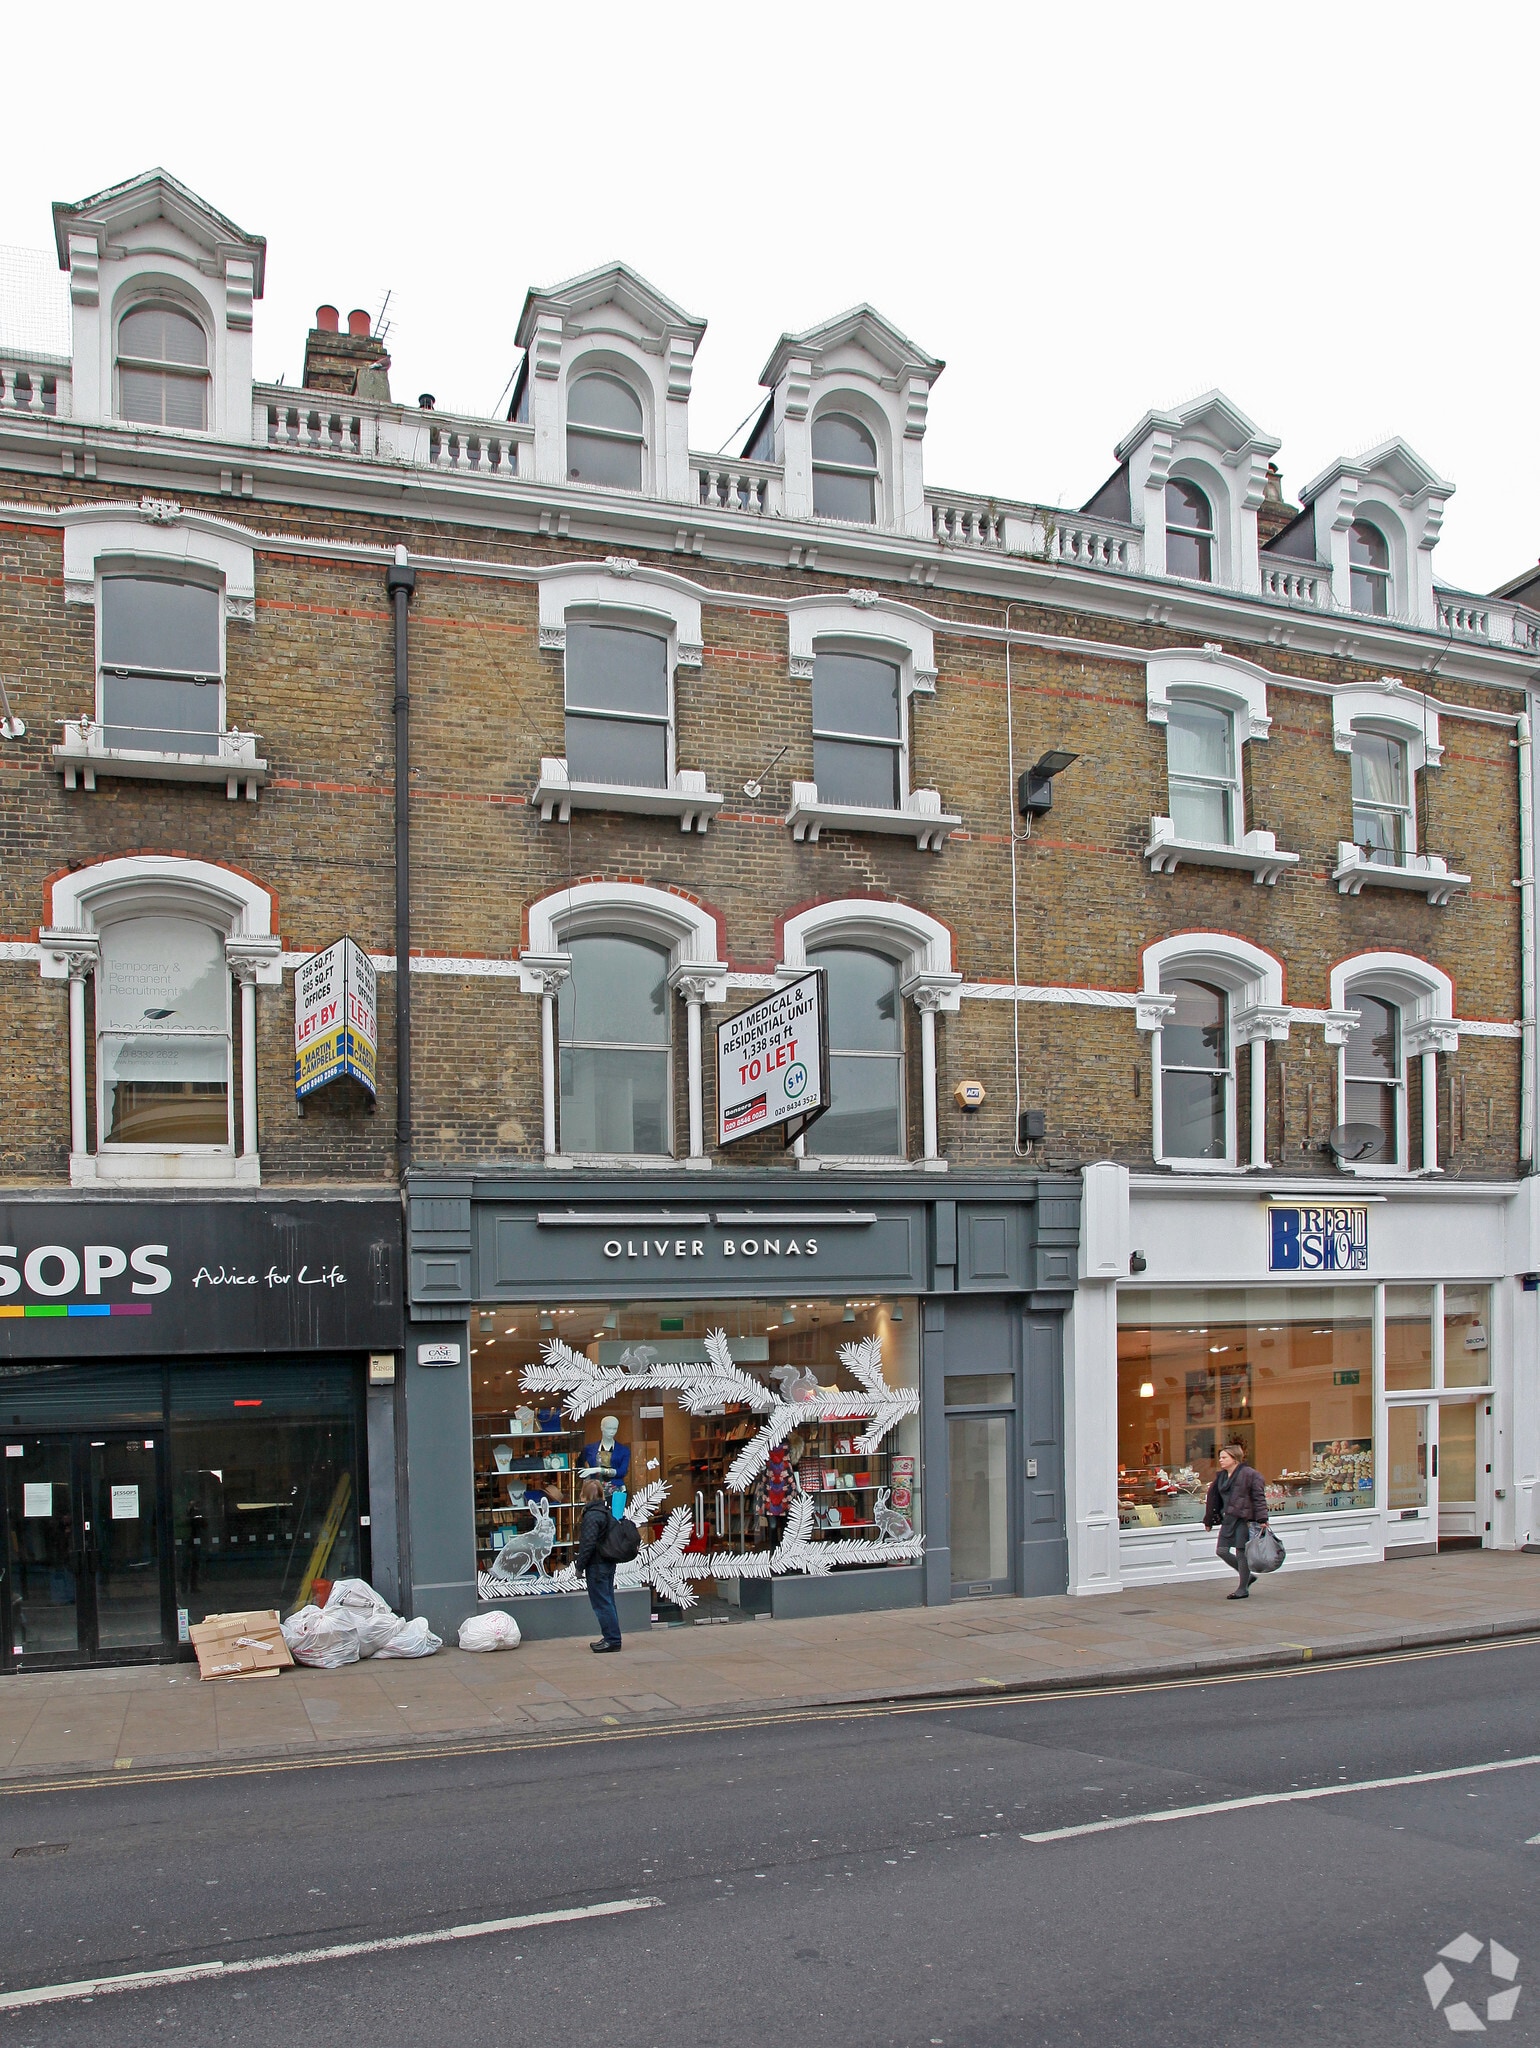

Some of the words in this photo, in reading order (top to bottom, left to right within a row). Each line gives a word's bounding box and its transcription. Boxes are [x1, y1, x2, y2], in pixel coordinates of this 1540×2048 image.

[109, 960, 169, 974] Temporary
[172, 963, 181, 973] &
[109, 973, 172, 984] Permanent
[302, 964, 313, 981] 356
[109, 984, 178, 997] Recruitment
[302, 980, 314, 996] 885
[304, 983, 331, 1009] OFFICES
[298, 1013, 318, 1041] LET
[320, 1000, 338, 1026] BY
[731, 1020, 744, 1037] D1
[746, 994, 793, 1029] MEDICAL
[795, 988, 804, 1002] &
[723, 1013, 786, 1056] RESIDENTIAL
[788, 998, 814, 1021] UNIT
[305, 1040, 332, 1066] MARTIN
[742, 1037, 768, 1060] 1,338
[769, 1033, 781, 1046] sq
[783, 1024, 793, 1039] ft
[302, 1050, 336, 1078] CAMPBELL
[738, 1058, 761, 1086] TO
[766, 1039, 799, 1073] LET
[774, 1109, 786, 1117] 020
[786, 1101, 802, 1112] 8434
[802, 1093, 817, 1106] 3522
[603, 1240, 705, 1257] OLIVER
[723, 1238, 818, 1256] BONAS
[192, 1266, 259, 1288] Advice
[264, 1265, 291, 1288] for
[297, 1265, 348, 1288] Life
[428, 1349, 452, 1357] CASE
[112, 1489, 137, 1497] JESSOPS
